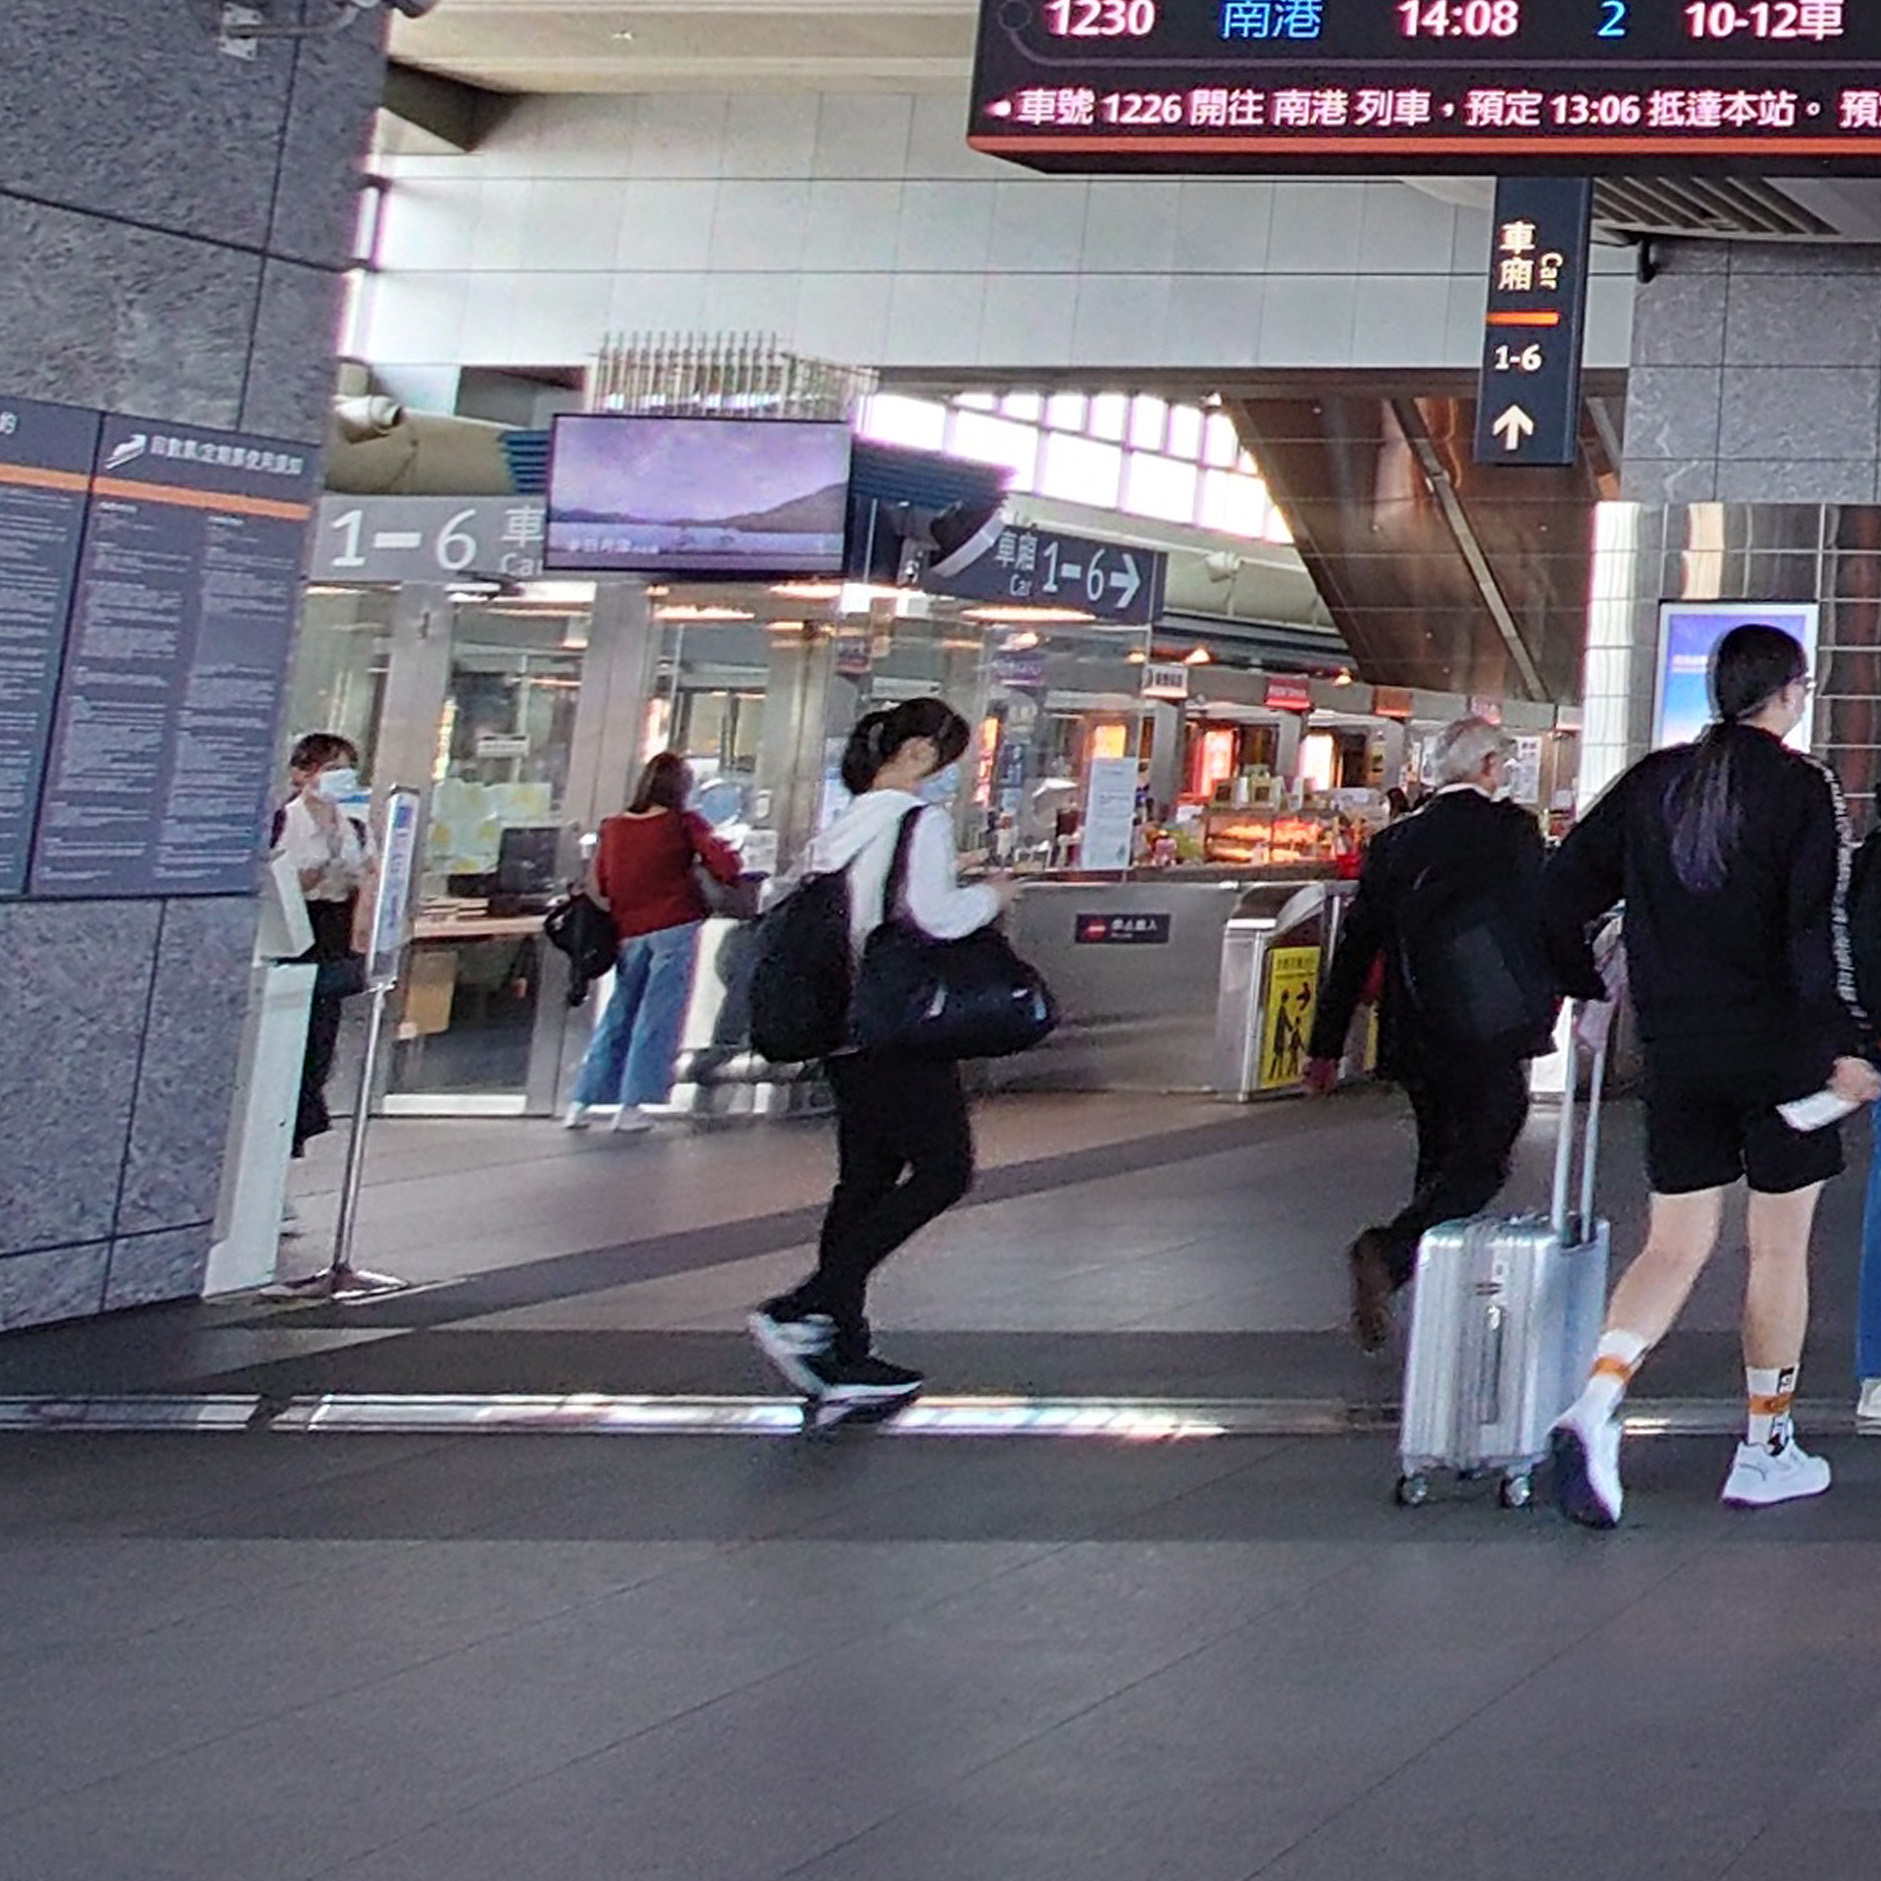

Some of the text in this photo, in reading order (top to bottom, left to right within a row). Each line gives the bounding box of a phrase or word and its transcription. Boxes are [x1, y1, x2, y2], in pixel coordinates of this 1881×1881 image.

[1596, 0, 1626, 37] 2
[1018, 87, 1096, 125] 車號
[1101, 92, 1183, 125] 1226
[1188, 88, 1265, 127] 開往
[1270, 87, 1349, 127] 南港
[1549, 94, 1641, 125] 13:06
[1540, 252, 1563, 290] Car
[1495, 344, 1542, 371] 1-6
[331, 509, 477, 570] 1-6
[1042, 541, 1105, 601] 1-6
